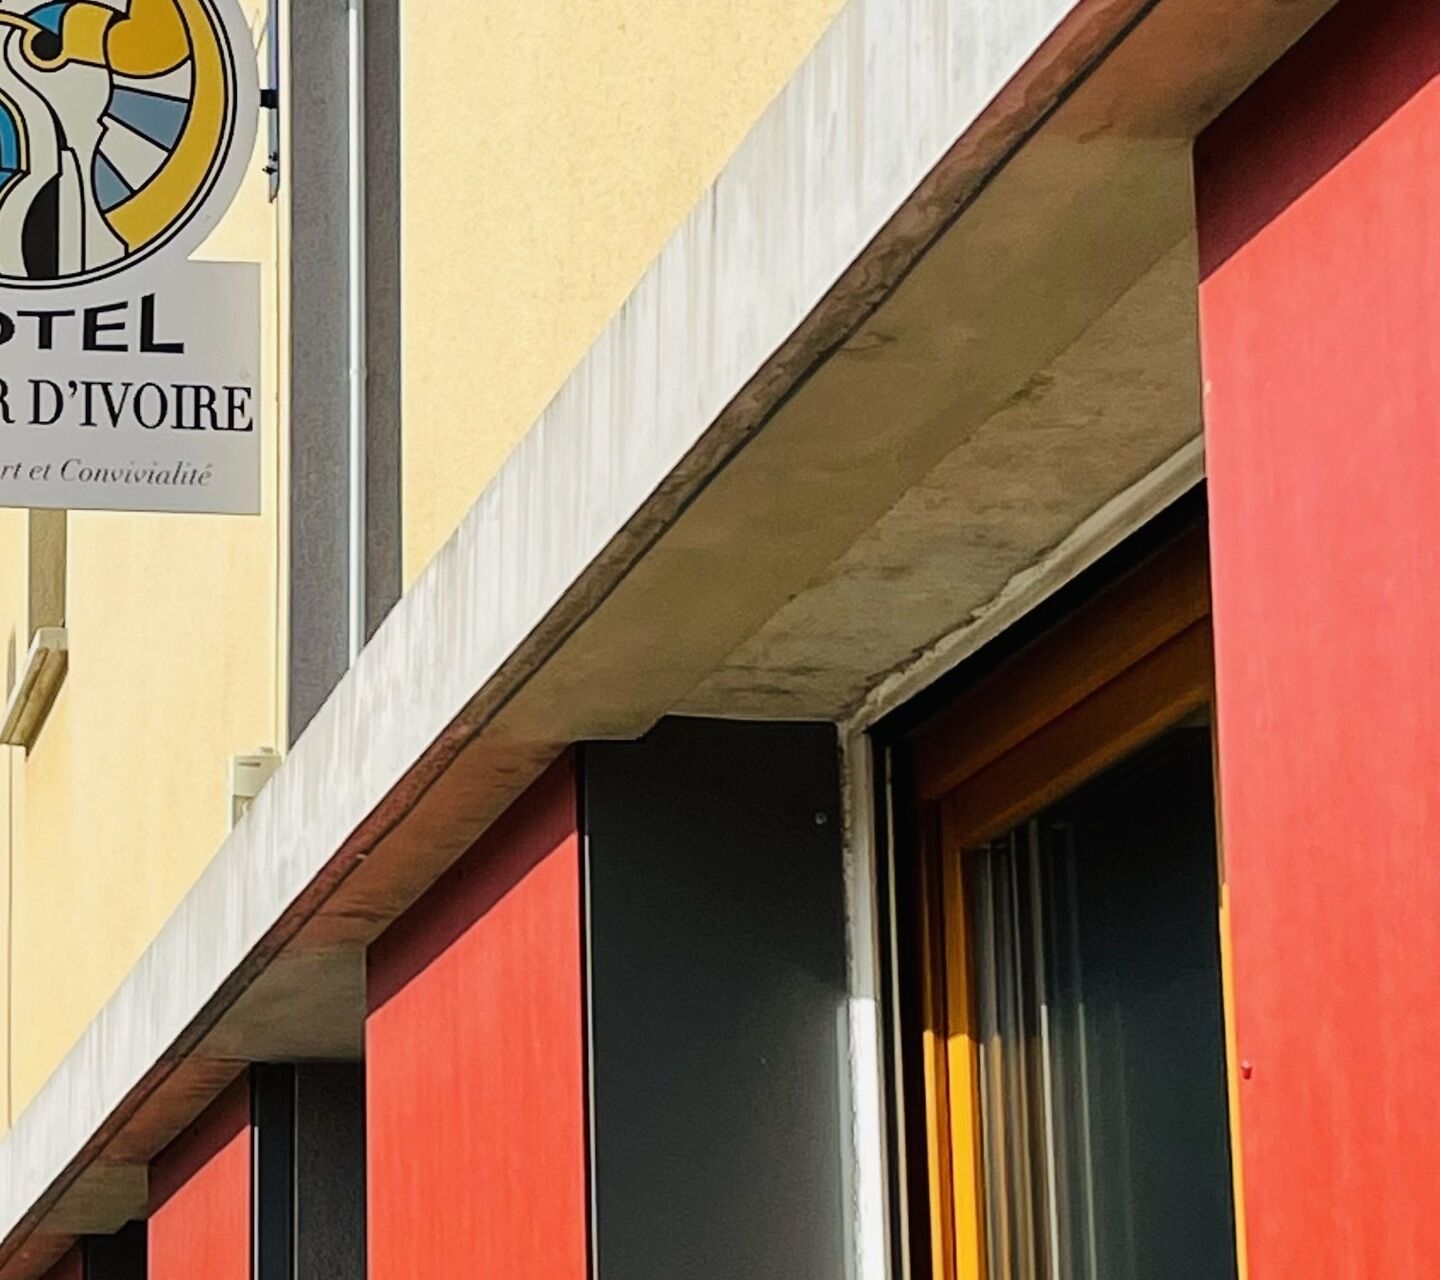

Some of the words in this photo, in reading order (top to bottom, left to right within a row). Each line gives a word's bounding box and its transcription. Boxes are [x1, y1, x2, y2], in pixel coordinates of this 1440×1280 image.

[27, 378, 254, 432] D'IVOIRE
[29, 462, 50, 480] et
[60, 457, 215, 488] Convivialité
